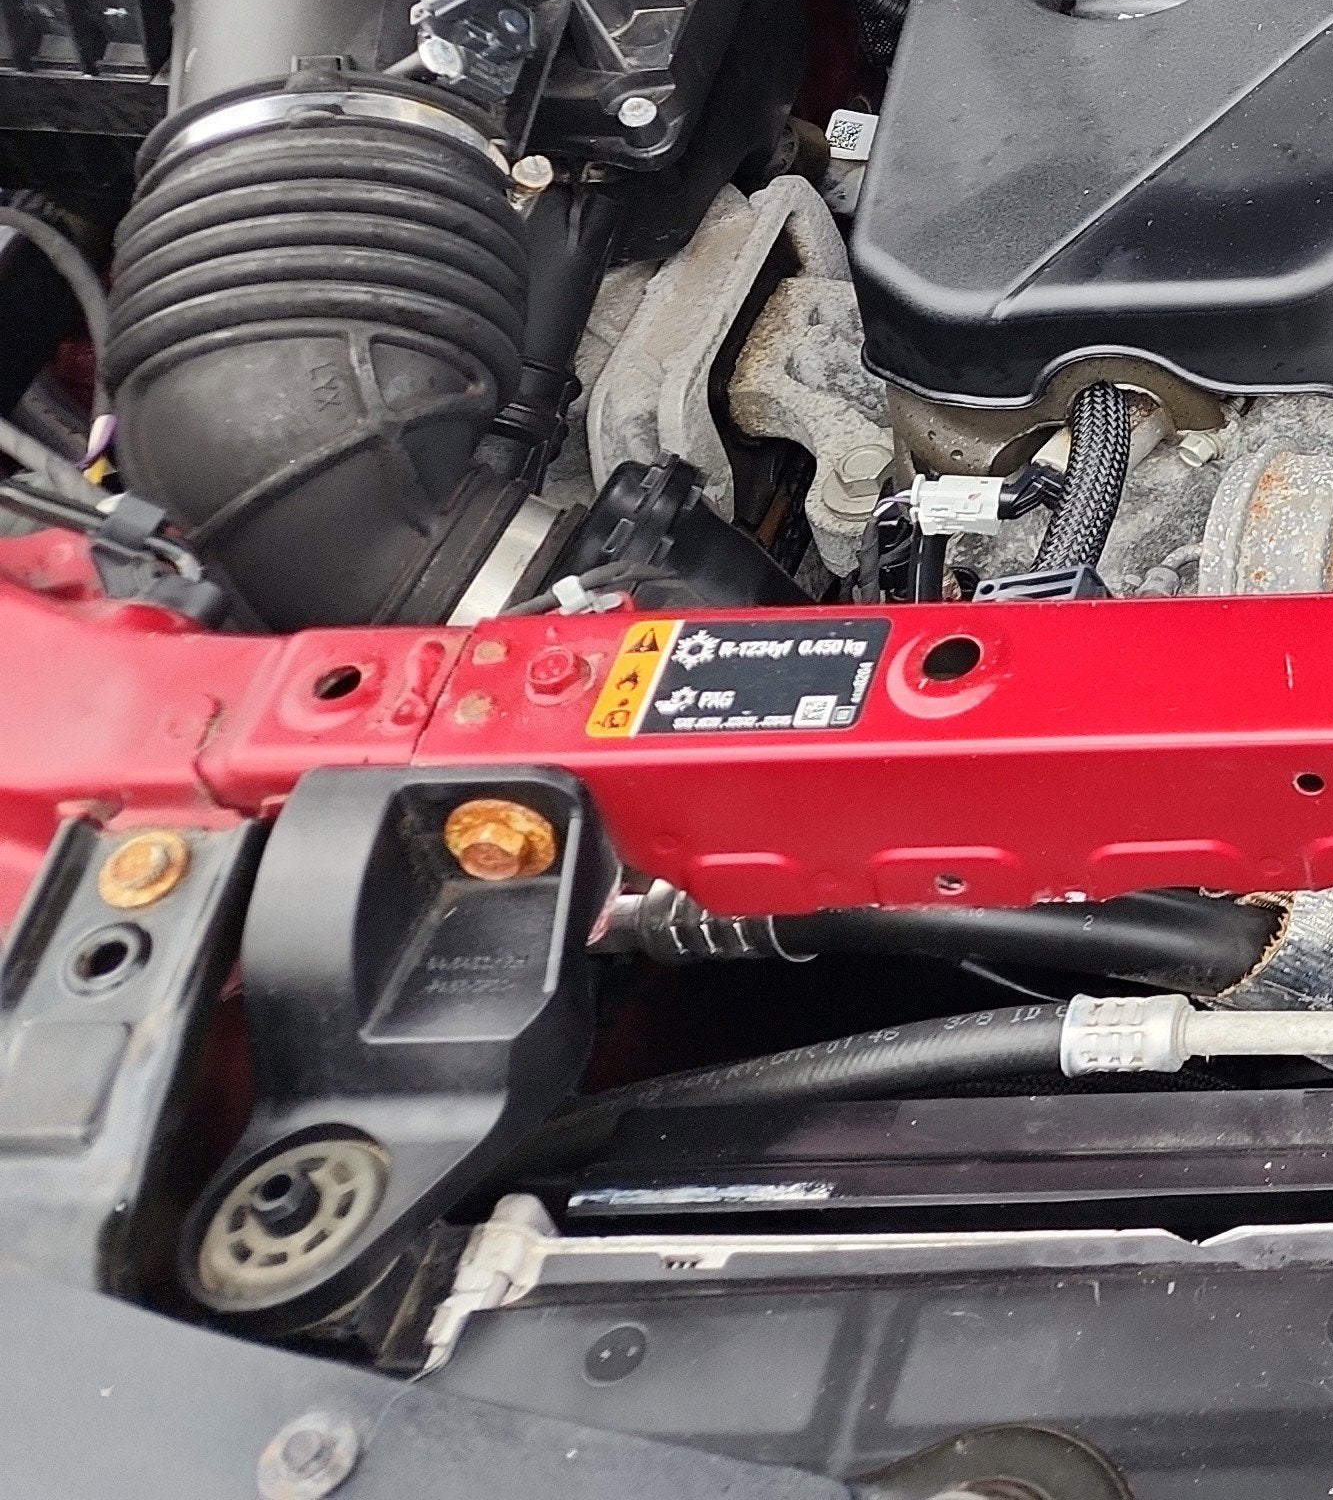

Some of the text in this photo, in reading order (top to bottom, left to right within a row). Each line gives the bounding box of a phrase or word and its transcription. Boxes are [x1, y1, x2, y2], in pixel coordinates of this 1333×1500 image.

[718, 638, 869, 660] R-1234yf 0.450 kg
[697, 690, 736, 710] PAG
[943, 1011, 995, 1030] 3/8
